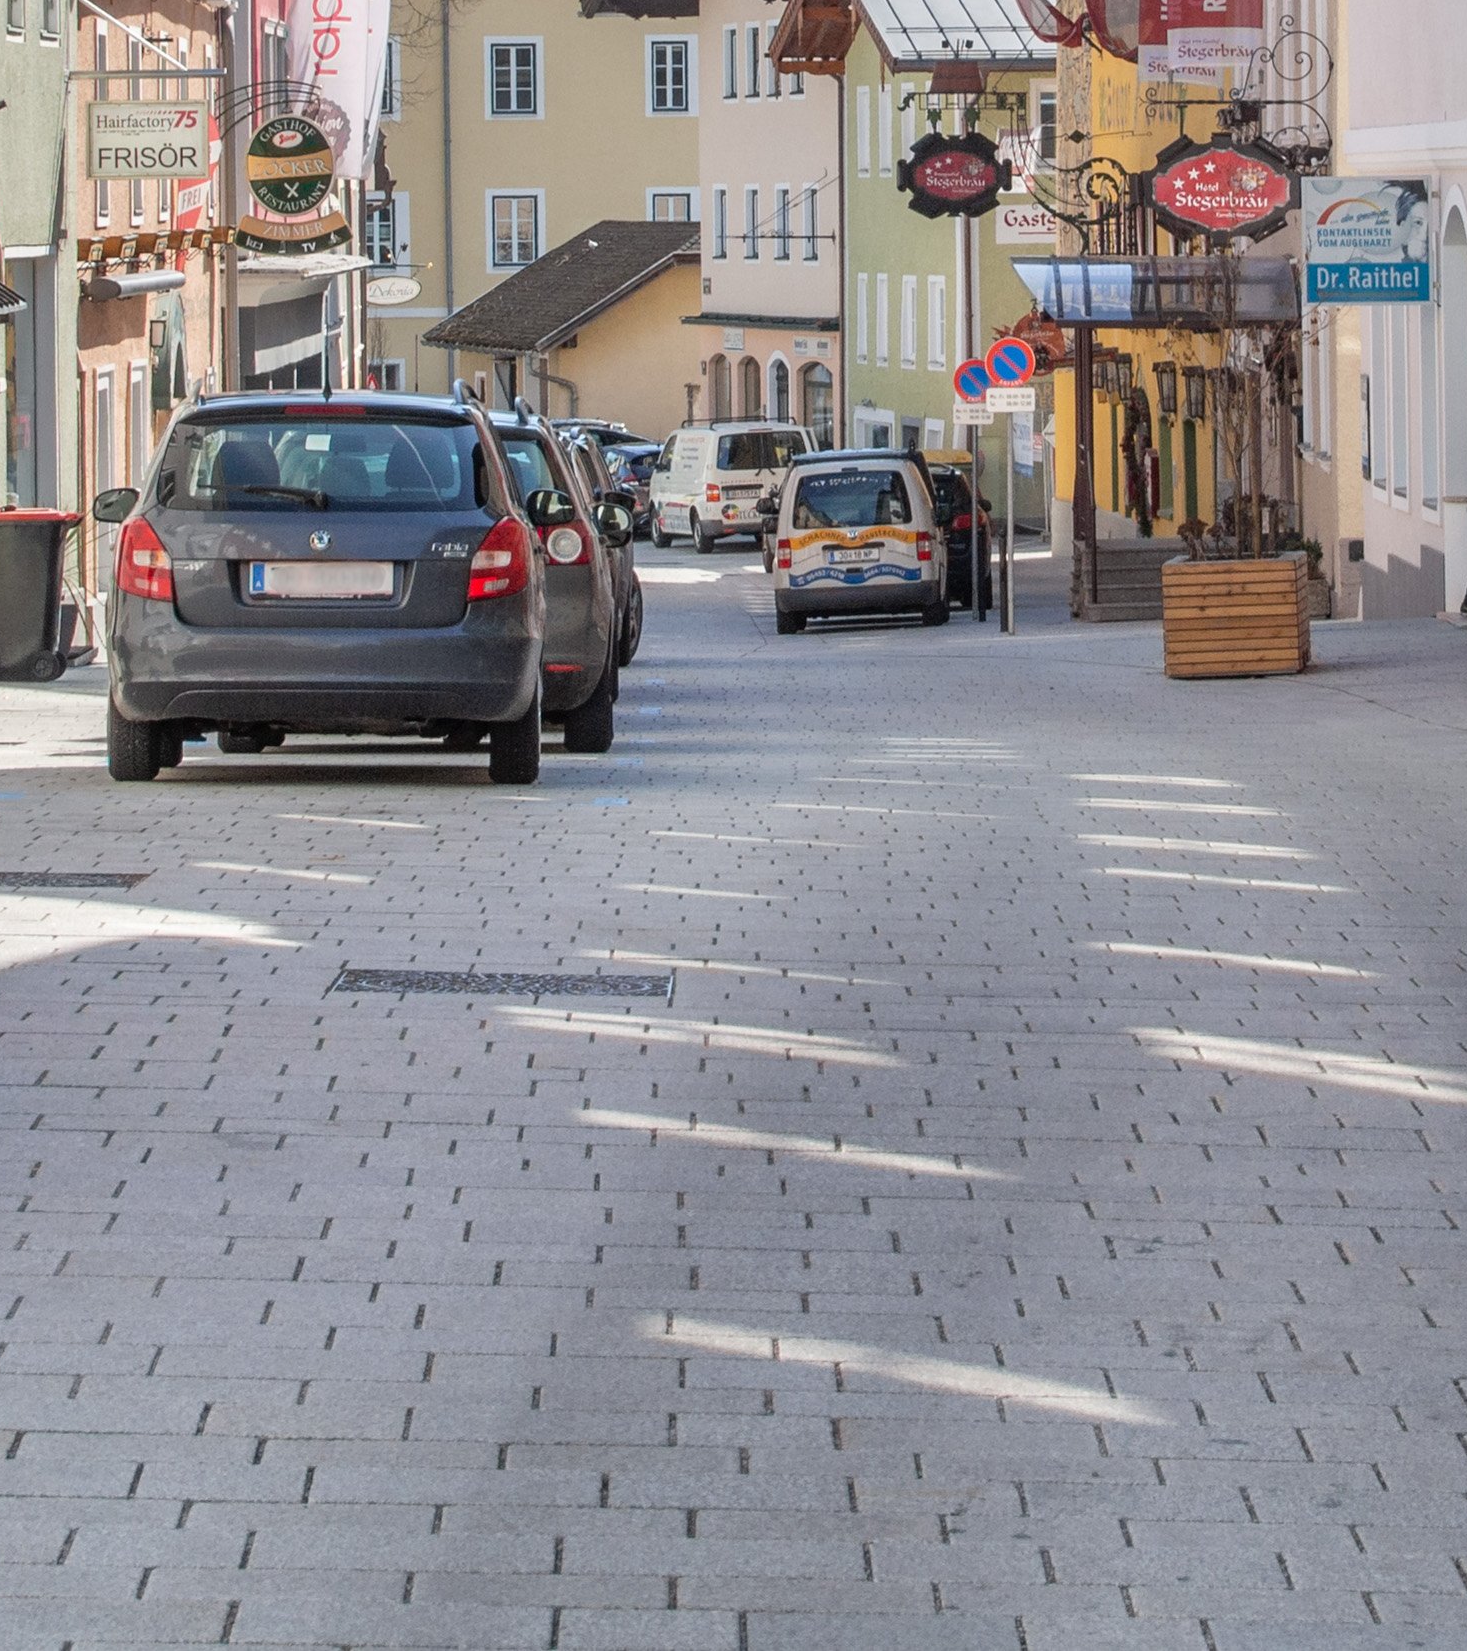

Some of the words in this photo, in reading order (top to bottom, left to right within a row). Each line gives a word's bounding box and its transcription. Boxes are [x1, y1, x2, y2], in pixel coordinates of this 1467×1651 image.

[1177, 44, 1254, 61] Stegerbräu
[259, 119, 317, 142] GASTHOF
[97, 142, 198, 169] FRISÖR
[926, 175, 986, 189] Stegerbräu
[1194, 182, 1219, 192] Hotel
[181, 188, 202, 210] FREI
[257, 181, 327, 212] RESTAURANT
[1175, 191, 1269, 211] Stegerbräu
[263, 222, 325, 238] ZIMMER
[1316, 228, 1392, 237] KONTAKTLINSEN
[302, 242, 317, 252] TV
[1318, 239, 1338, 247] VOM
[1340, 238, 1392, 247] AUGENARZT
[1316, 266, 1344, 289] Dr.
[1348, 266, 1420, 289] Raithel
